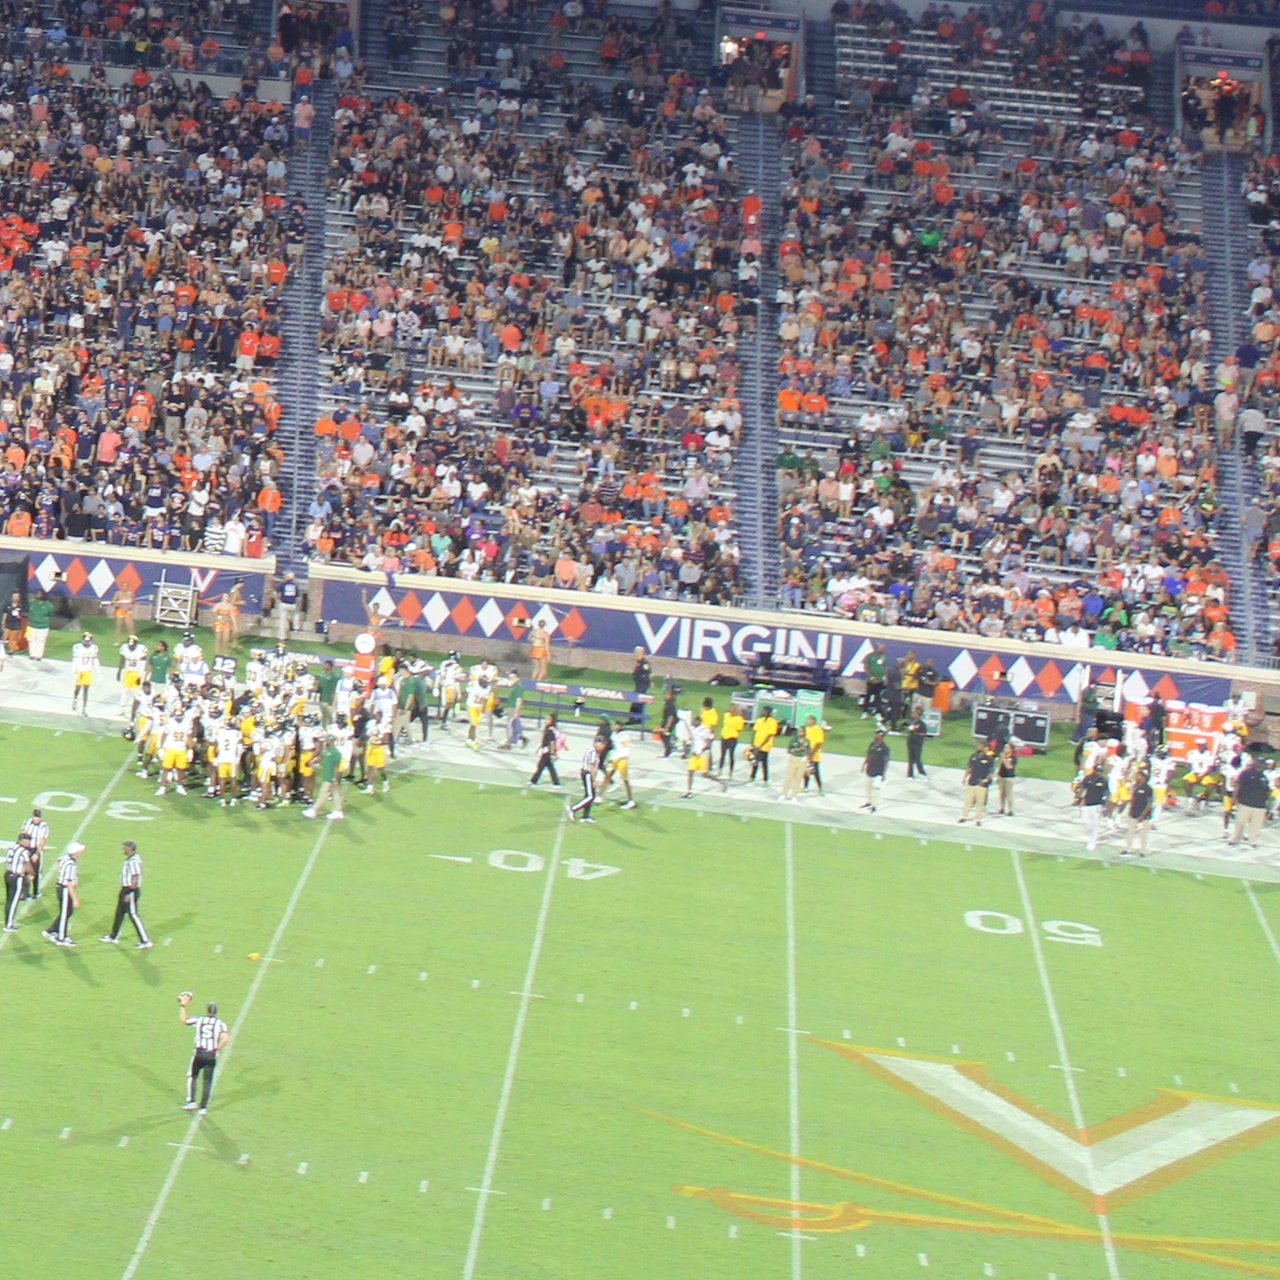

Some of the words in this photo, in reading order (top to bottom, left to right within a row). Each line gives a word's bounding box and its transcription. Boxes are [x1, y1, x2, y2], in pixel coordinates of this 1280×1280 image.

[634, 613, 876, 677] VIRGINIA
[214, 657, 237, 670] 12
[579, 686, 626, 701] VIRGINIA
[31, 791, 162, 822] 30
[488, 847, 621, 881] 40
[963, 909, 1104, 948] 50
